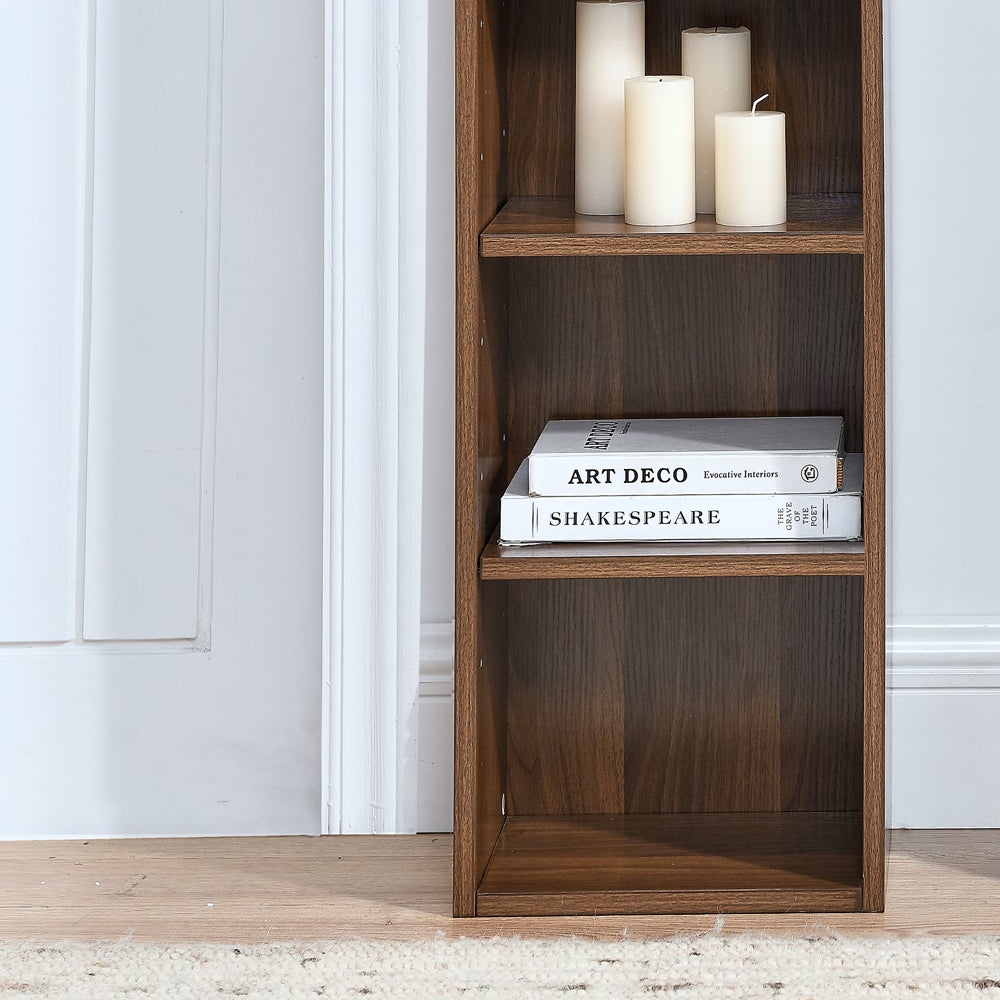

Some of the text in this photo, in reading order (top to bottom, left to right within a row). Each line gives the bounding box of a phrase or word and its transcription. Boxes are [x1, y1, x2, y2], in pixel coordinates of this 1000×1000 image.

[567, 467, 688, 485] ART DECO
[703, 469, 779, 480] Evocative Interiors
[548, 509, 721, 527] SHAKESPEARE
[785, 501, 793, 531] GRAVE
[793, 510, 801, 523] OF
[810, 504, 818, 527] POET
